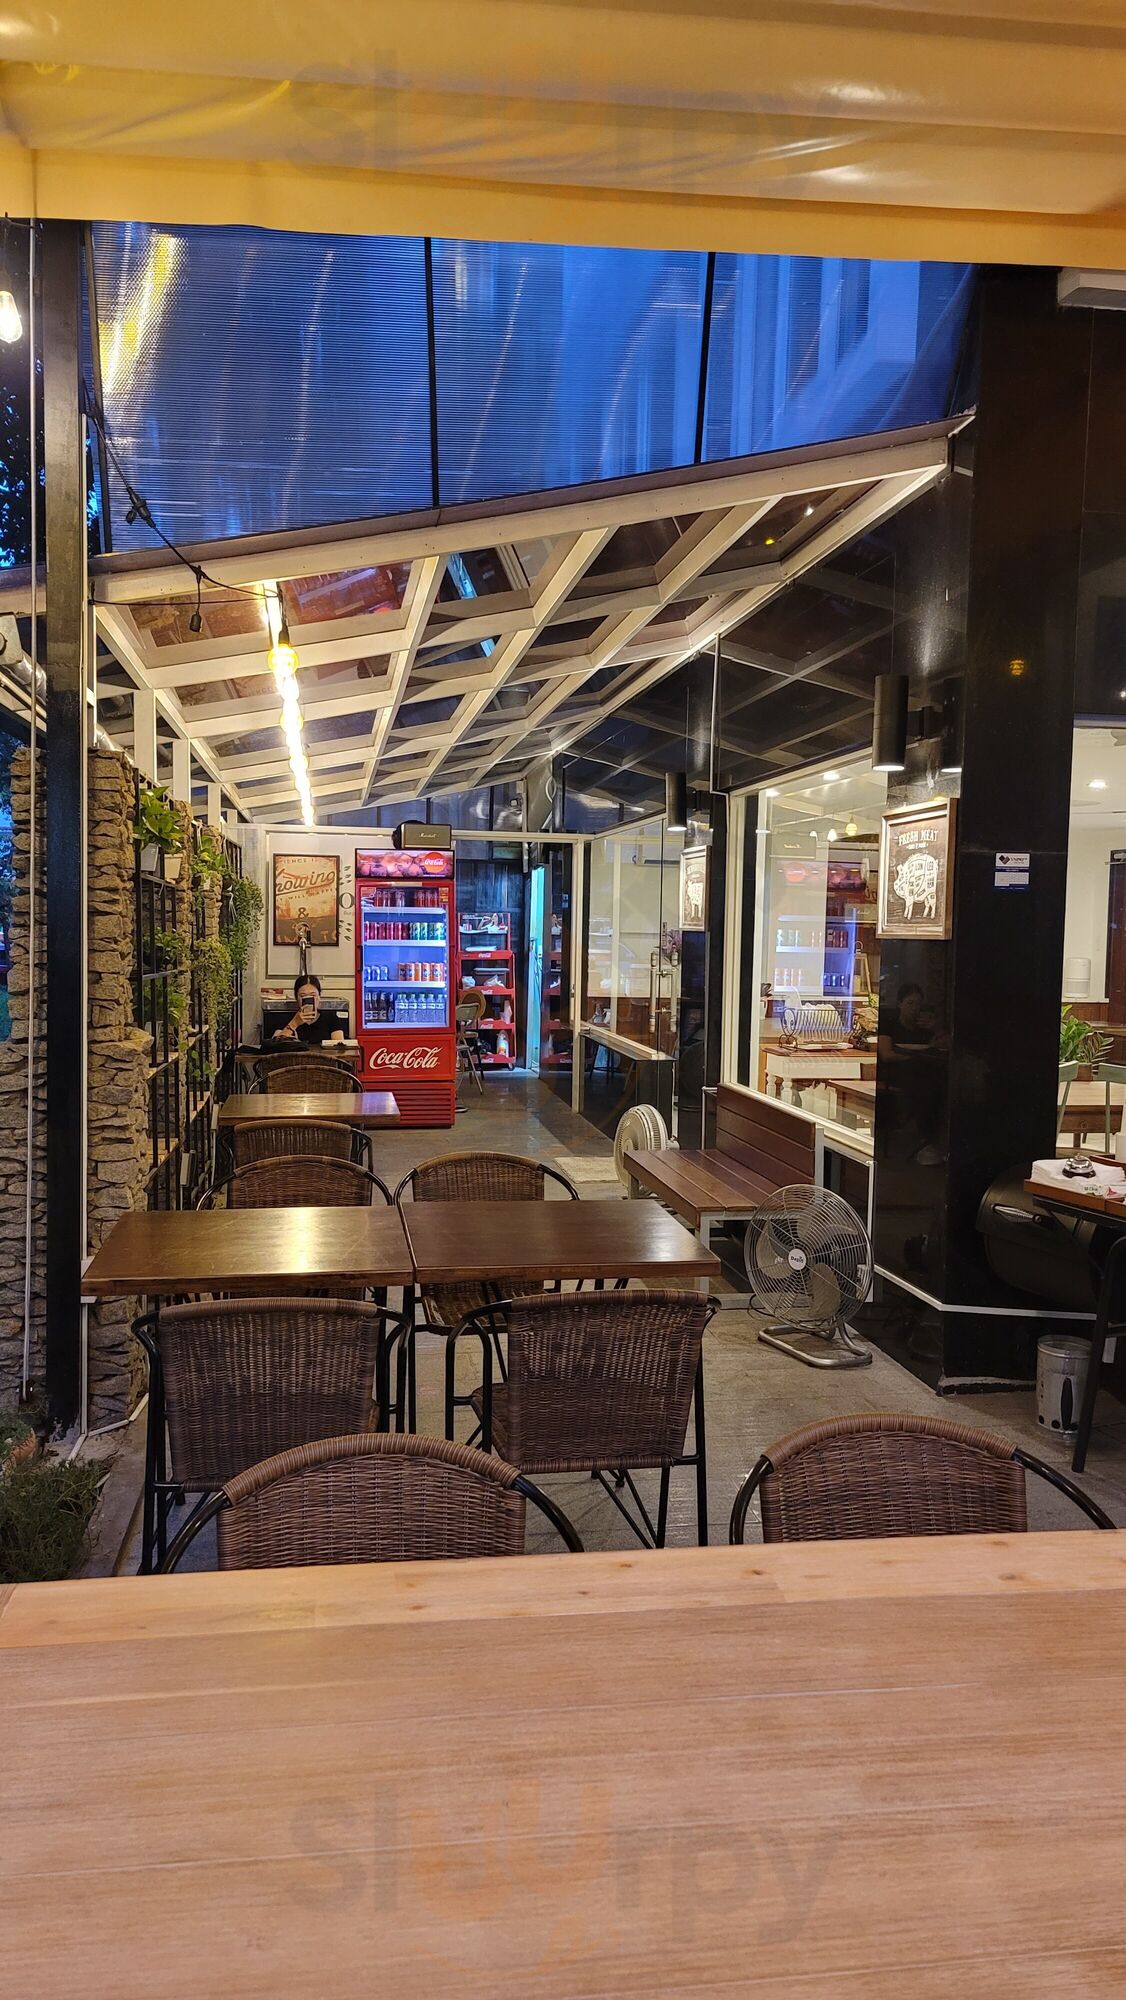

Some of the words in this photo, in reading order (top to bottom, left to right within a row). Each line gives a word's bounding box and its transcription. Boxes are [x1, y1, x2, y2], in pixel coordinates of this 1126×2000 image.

[899, 831, 919, 846] FRESH
[920, 829, 939, 841] MEAT
[369, 1046, 442, 1070] Coca-Cola
